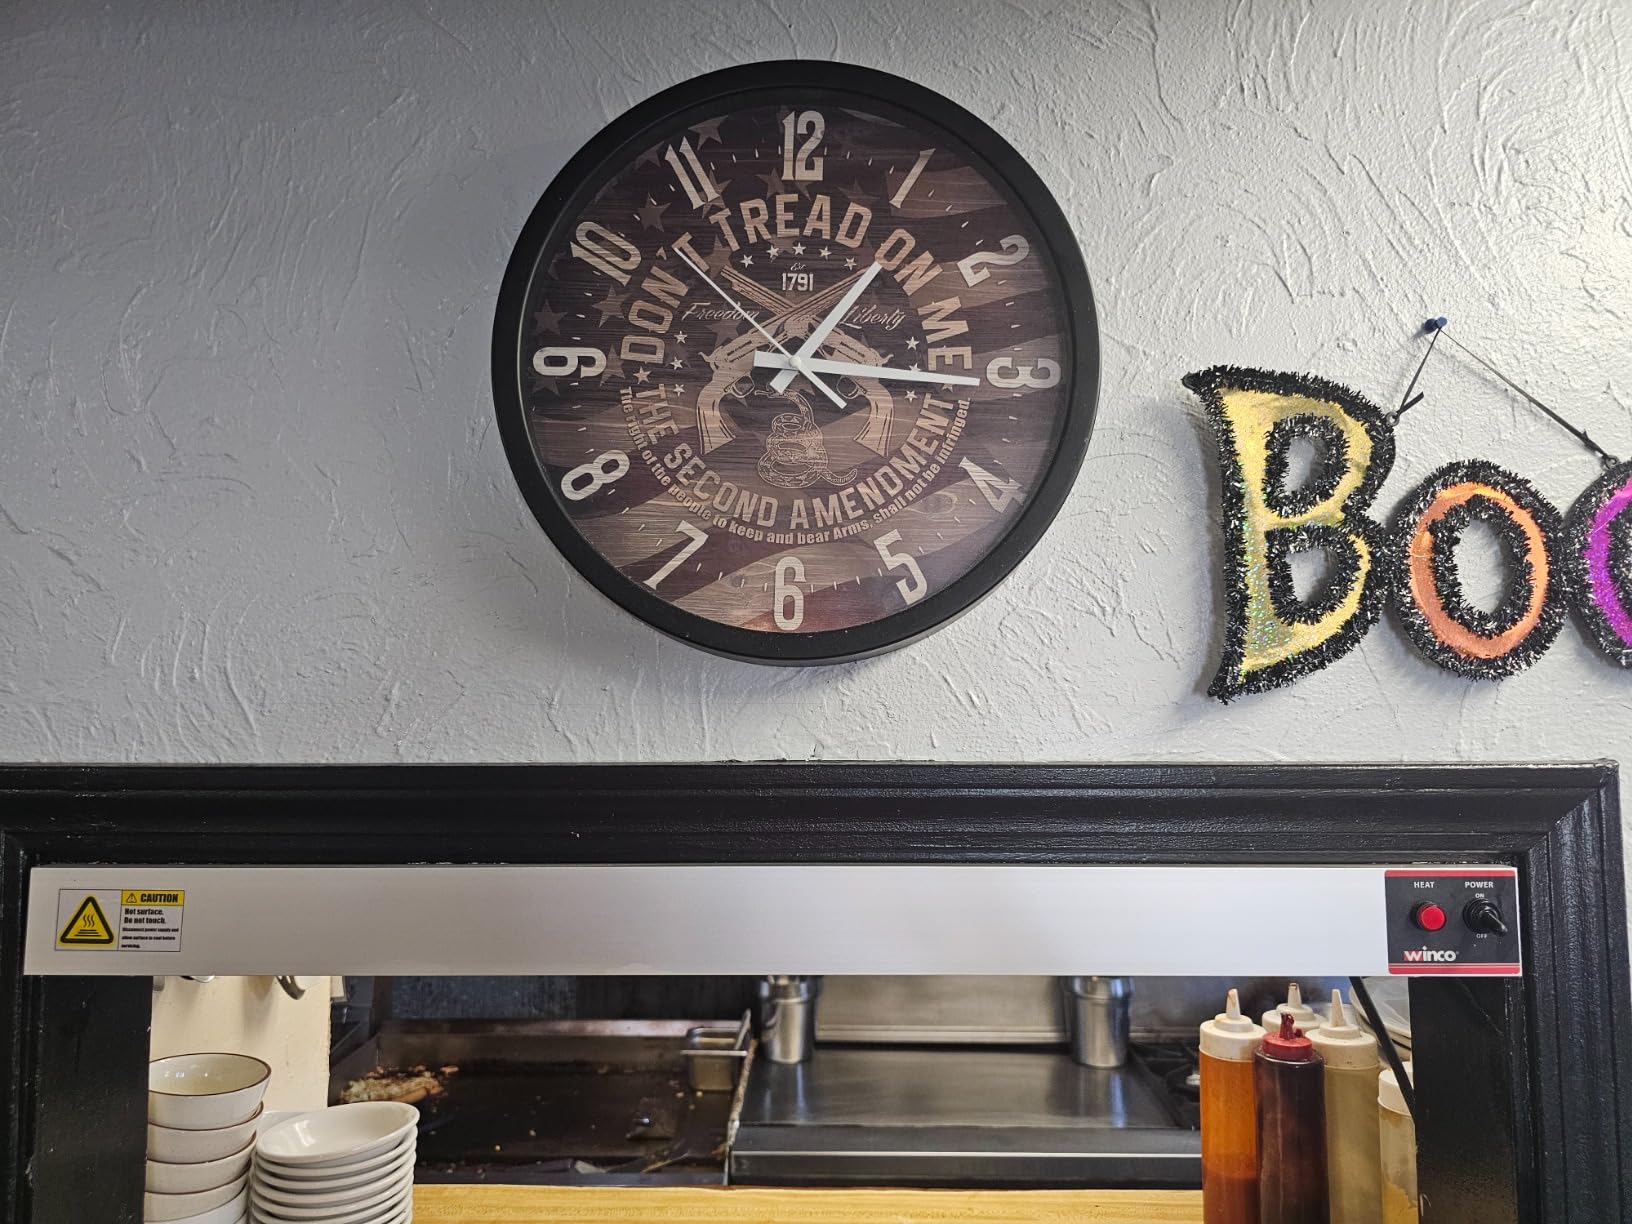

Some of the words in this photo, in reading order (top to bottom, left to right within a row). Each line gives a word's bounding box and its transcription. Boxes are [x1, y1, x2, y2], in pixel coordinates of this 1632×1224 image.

[781, 110, 825, 181] 12
[665, 136, 721, 209] 11
[889, 148, 936, 208] 1
[570, 221, 642, 287] 10
[957, 234, 1030, 288] 2
[620, 231, 710, 364] DON'T
[709, 193, 873, 251] TREAD
[875, 228, 943, 296] ON
[917, 296, 973, 371] ME
[782, 272, 814, 292] 1791
[840, 304, 906, 331] Liberty
[533, 347, 606, 379] 9
[986, 357, 1062, 389] 3
[620, 386, 634, 414] The
[625, 414, 649, 451] right
[934, 397, 971, 465] infringed.
[635, 383, 680, 445] THE
[663, 442, 779, 528] SECOND
[788, 393, 954, 530] AMENDMENT
[641, 449, 659, 465] of
[921, 463, 941, 482] be
[561, 450, 630, 500] 8
[651, 463, 671, 486] the
[904, 478, 928, 501] not
[959, 456, 1024, 513] 4
[667, 483, 712, 520] people
[872, 495, 908, 524] shall
[712, 514, 728, 529] to
[728, 520, 764, 542] keep
[797, 530, 830, 545] bear
[833, 519, 874, 540] Arms,
[766, 532, 794, 545] and
[643, 520, 709, 590] 7
[873, 529, 928, 605] 5
[774, 556, 808, 631] 6
[140, 893, 179, 903] CAUTION
[124, 916, 133, 924] Do
[1403, 945, 1457, 962] winco
